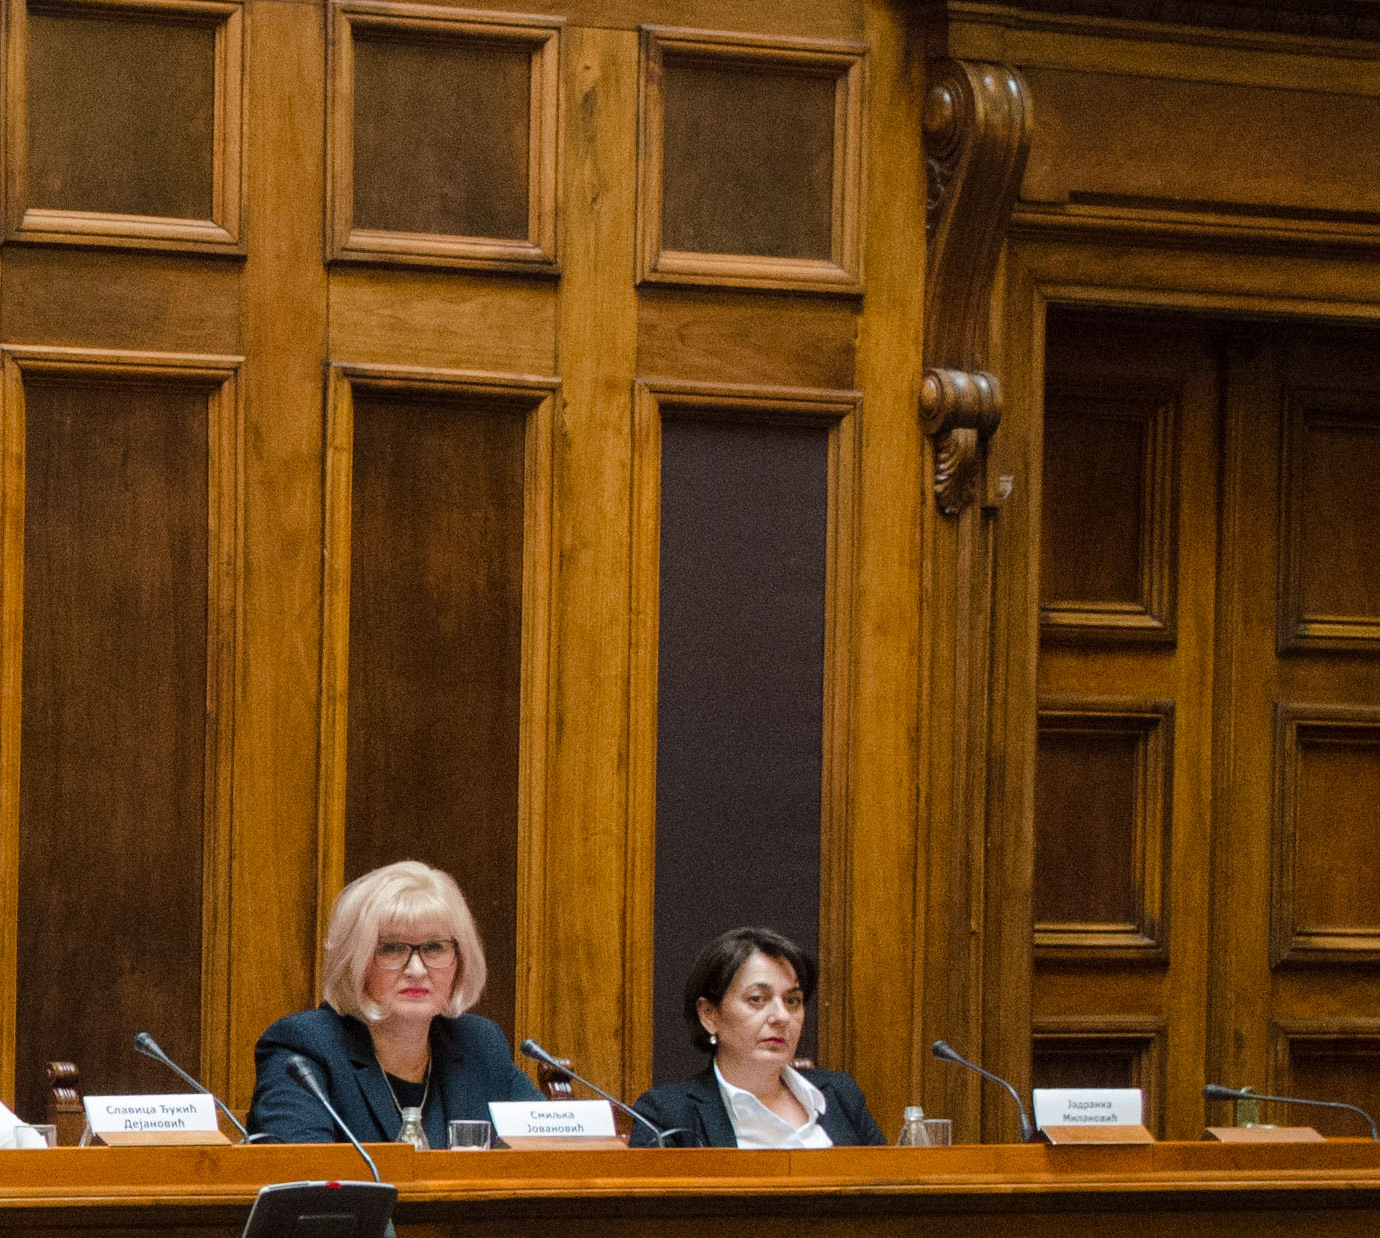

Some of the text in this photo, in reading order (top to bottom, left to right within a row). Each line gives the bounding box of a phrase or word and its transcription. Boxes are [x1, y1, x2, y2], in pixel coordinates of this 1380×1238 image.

[105, 1104, 198, 1116] Славица Ђукић
[123, 1118, 185, 1131] Дејановић
[527, 1123, 585, 1133] Јовановић
